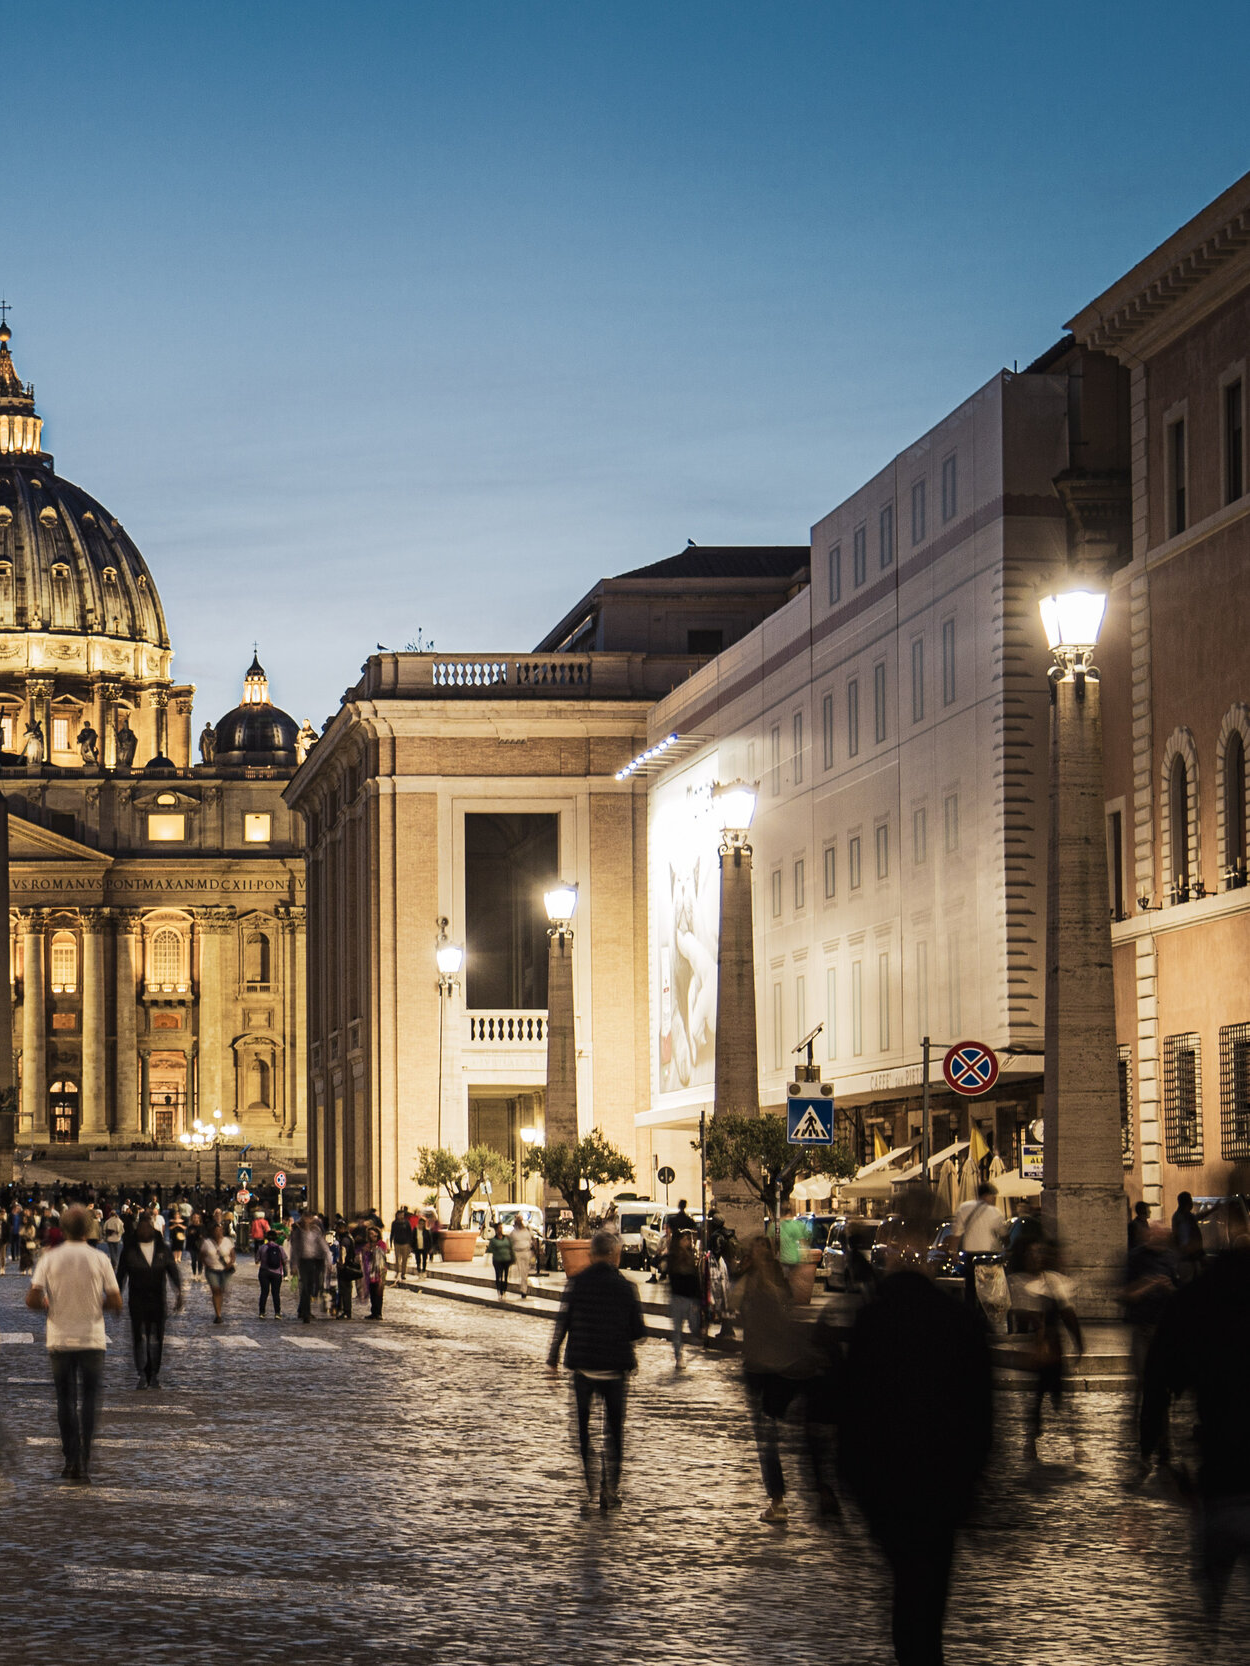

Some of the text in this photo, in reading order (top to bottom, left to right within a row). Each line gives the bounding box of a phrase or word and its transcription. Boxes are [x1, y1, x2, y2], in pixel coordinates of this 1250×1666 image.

[31, 879, 103, 890] ROMANVS
[106, 879, 142, 890] PONT
[143, 879, 174, 890] MAX
[175, 879, 194, 890] AN
[197, 879, 253, 890] MDCXII
[256, 879, 293, 890] PONT
